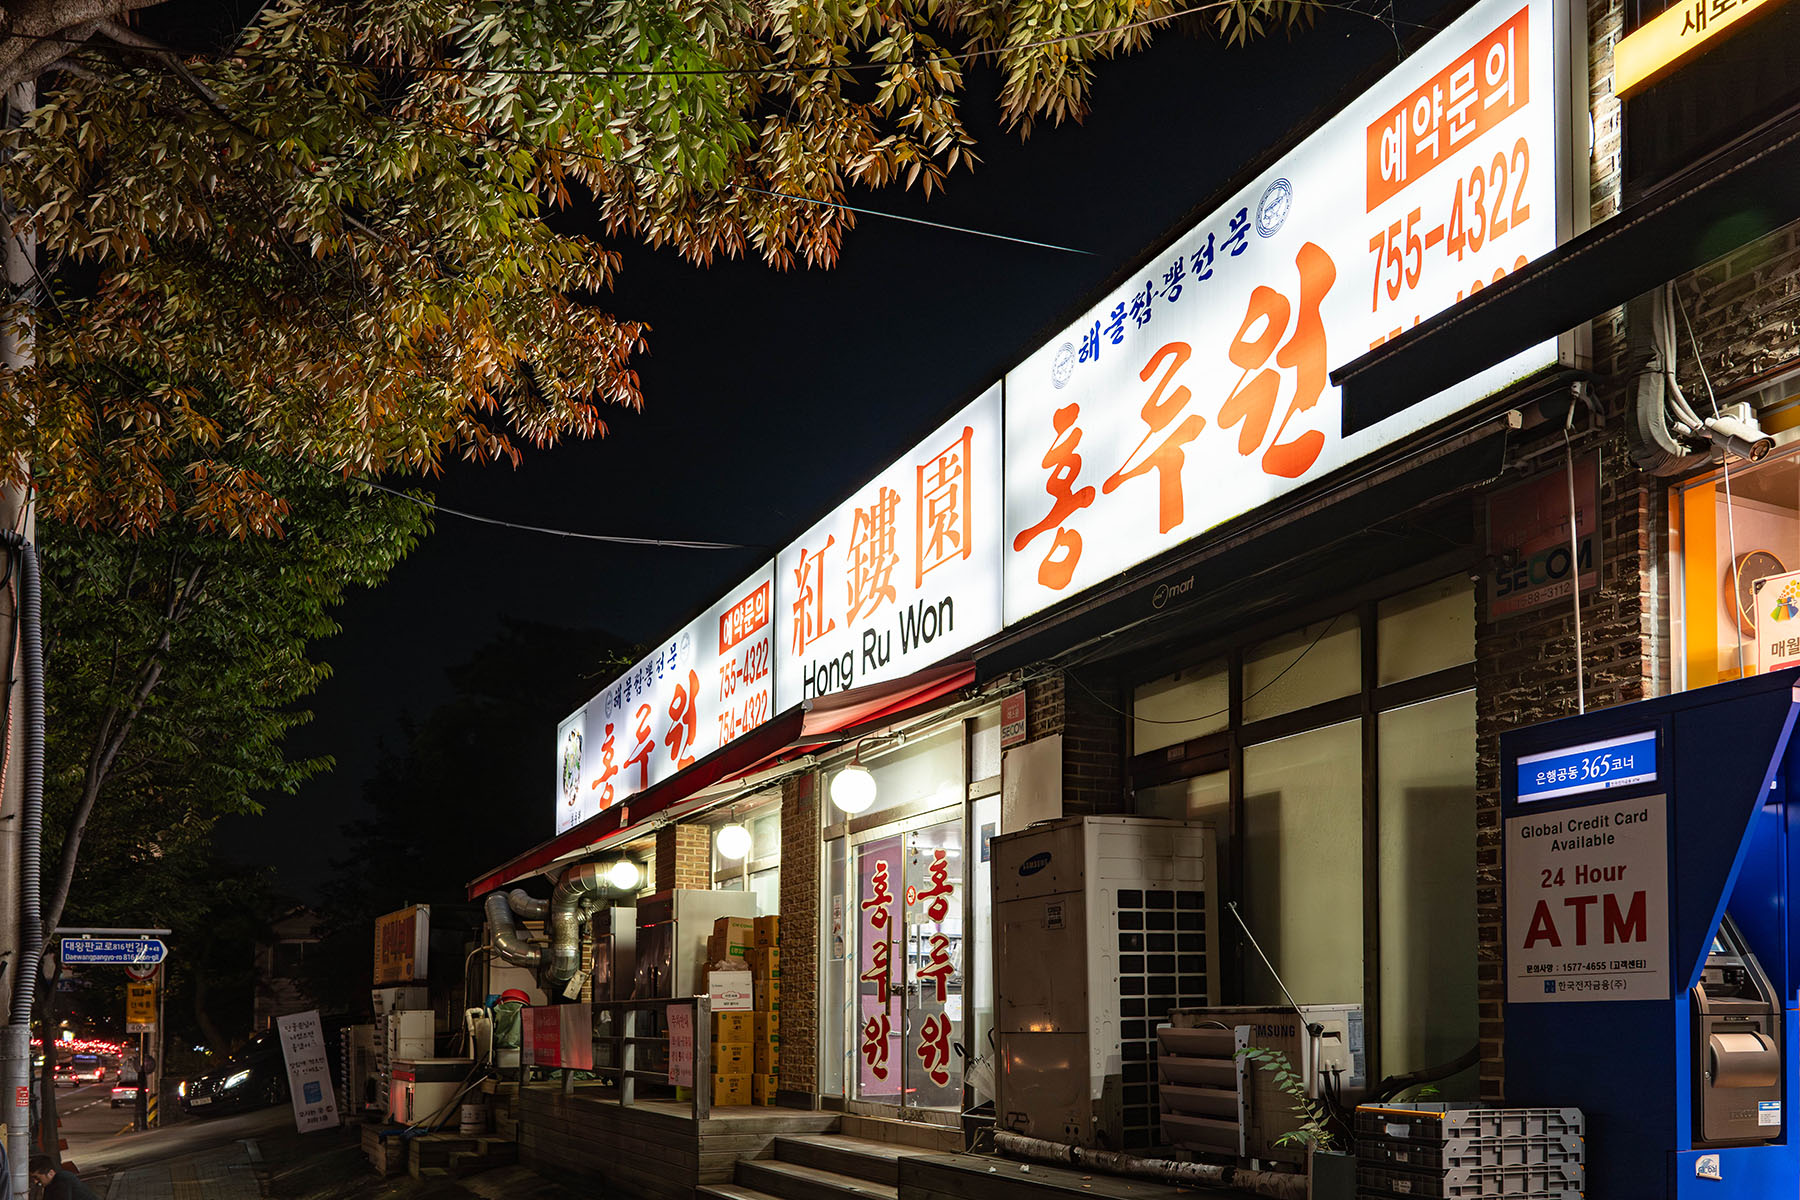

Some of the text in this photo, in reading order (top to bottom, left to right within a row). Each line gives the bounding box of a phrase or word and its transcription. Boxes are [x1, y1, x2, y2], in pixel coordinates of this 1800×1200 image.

[1681, 0, 1748, 36] 새로
[1380, 26, 1515, 184] 예약문의
[1369, 136, 1530, 313] 755-4322
[1013, 241, 1337, 591] 홍루원
[723, 587, 766, 645] 예약문의
[719, 637, 769, 702] 755-4322
[803, 596, 954, 700] Hong Ru Won
[1771, 637, 1800, 657] 매월
[718, 689, 768, 748] 754-4322
[1001, 720, 1025, 739] SECOM
[1535, 765, 1579, 786] 은행공동
[1521, 808, 1648, 839] Global Credit Card
[1551, 833, 1615, 852] Available
[1541, 864, 1627, 888] 24 Hour
[1523, 890, 1647, 949] ATM
[861, 860, 893, 1083] 홍루원
[917, 848, 954, 1088] 홍루원
[1558, 979, 1627, 992] 한국전자금융(주)
[1562, 961, 1607, 972] 1577-4655
[1255, 1024, 1296, 1038] MSUNG
